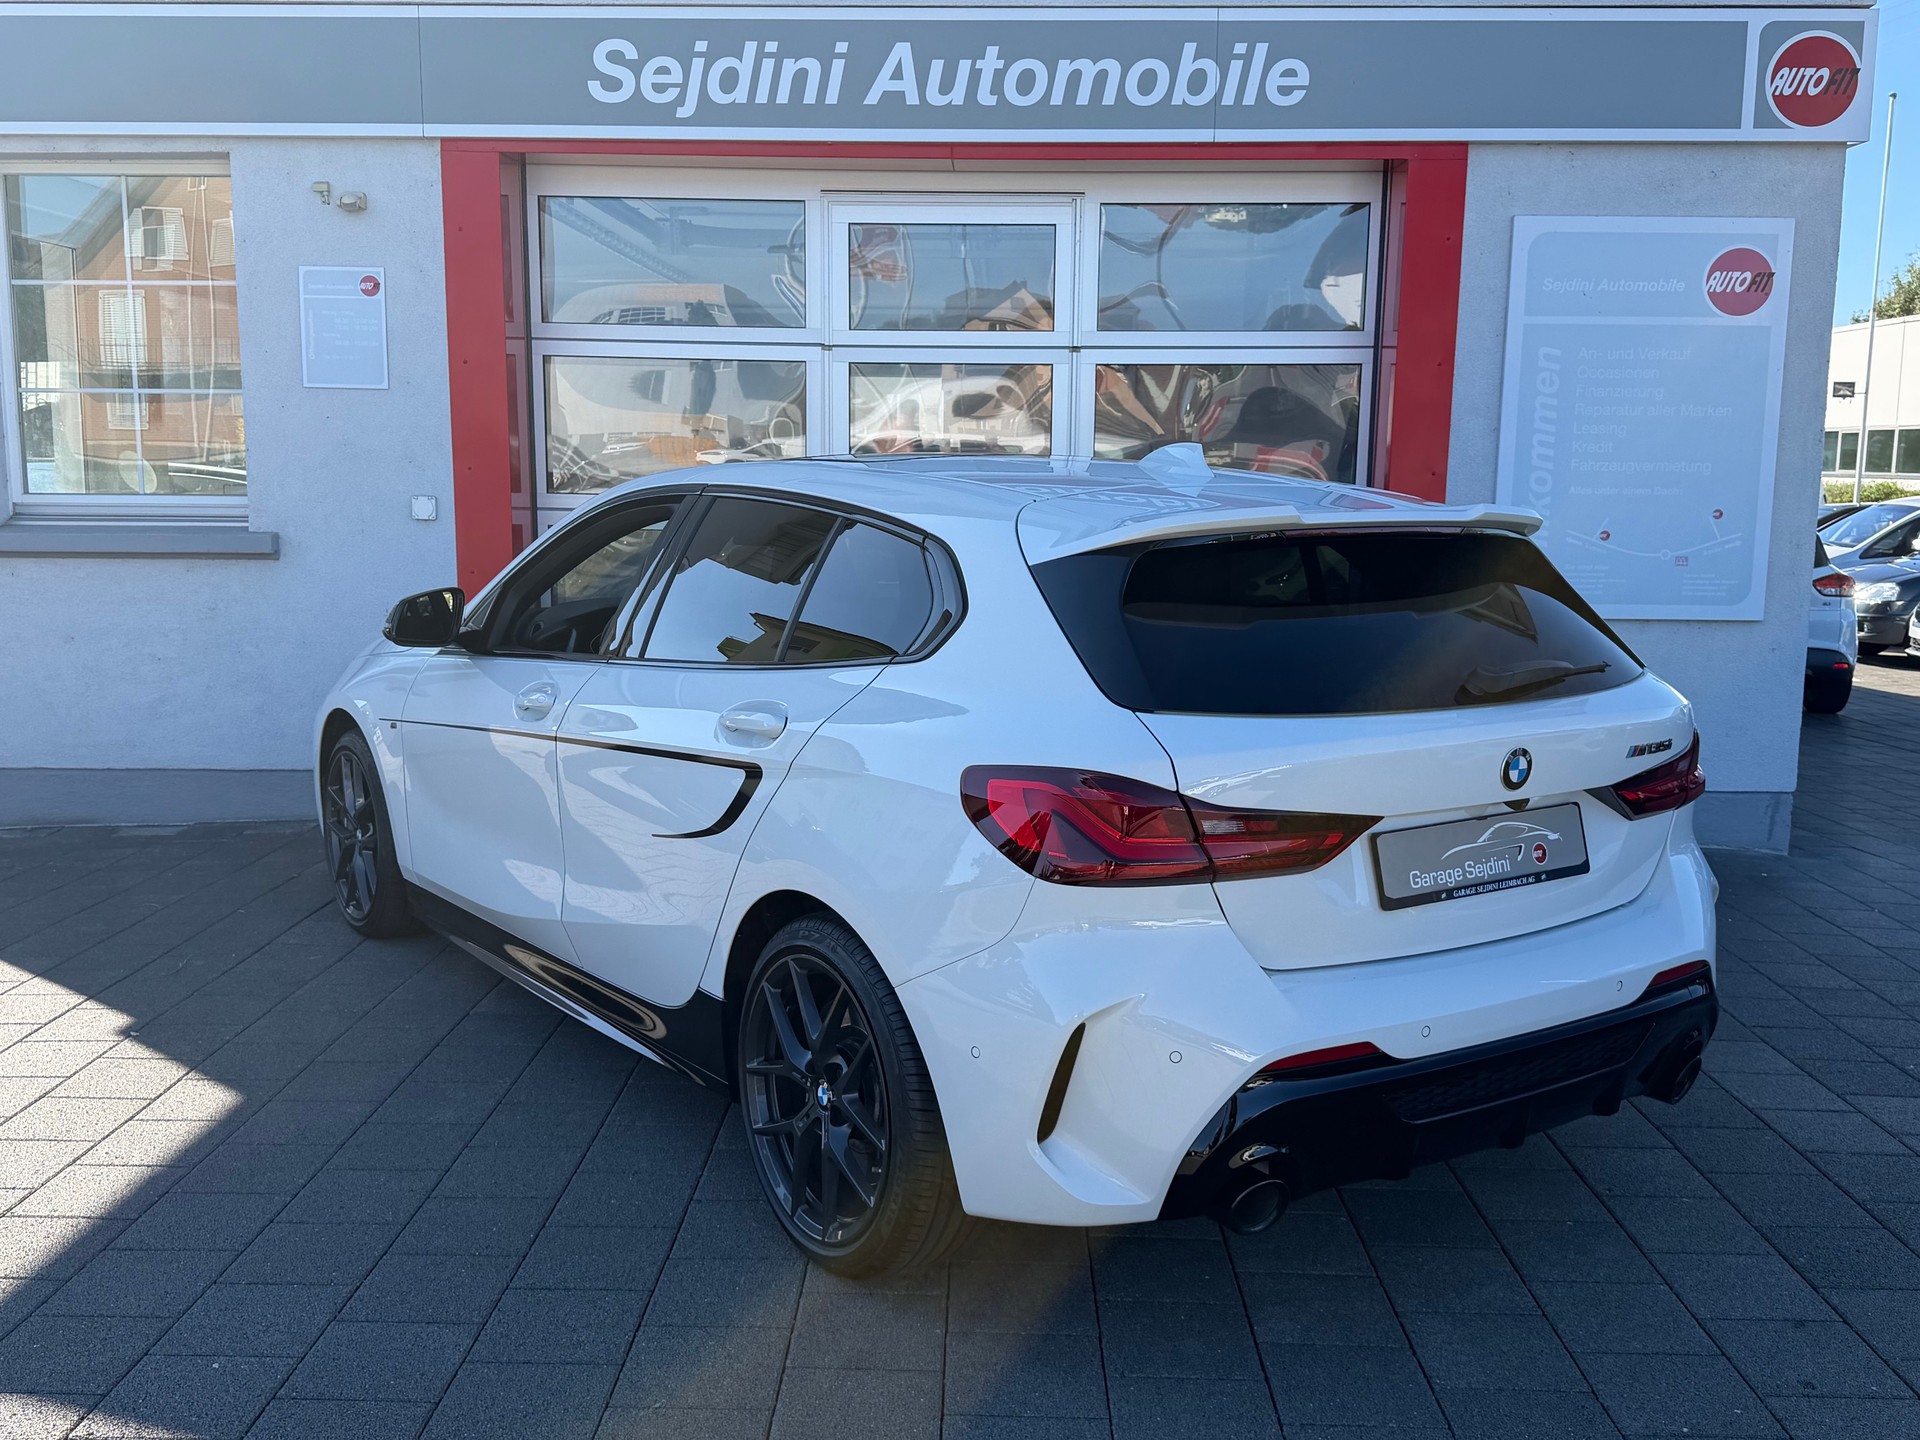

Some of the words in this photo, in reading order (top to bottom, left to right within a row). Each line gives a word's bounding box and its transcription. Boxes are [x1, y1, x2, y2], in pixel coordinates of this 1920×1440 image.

[587, 39, 847, 118] Sejdini
[863, 42, 1310, 107] Automobile
[1770, 67, 1861, 96] AUTOFIT
[1542, 278, 1595, 294] Sejdini
[1598, 278, 1686, 293] Automobile
[1705, 271, 1776, 295] AUTOFIT
[1577, 348, 1602, 361] An-
[1607, 348, 1634, 361] und
[1639, 348, 1691, 361] Verkauf
[1577, 366, 1660, 380] Occasionen
[1575, 385, 1665, 401] Finanzierung
[1574, 404, 1643, 420] Reparatur
[1648, 404, 1676, 418] aller
[1680, 405, 1733, 418] Marken
[1573, 423, 1628, 437] Leasing
[1572, 441, 1614, 454] Kredit
[1570, 459, 1713, 476] Fahrzeugvermietung
[1409, 867, 1463, 889] Garage
[1464, 855, 1511, 880] Sejdini
[1453, 885, 1477, 898] GARAGE
[1476, 882, 1500, 894] SEJDINI
[1499, 878, 1526, 890] LEIMBACH
[1525, 875, 1536, 885] AG
